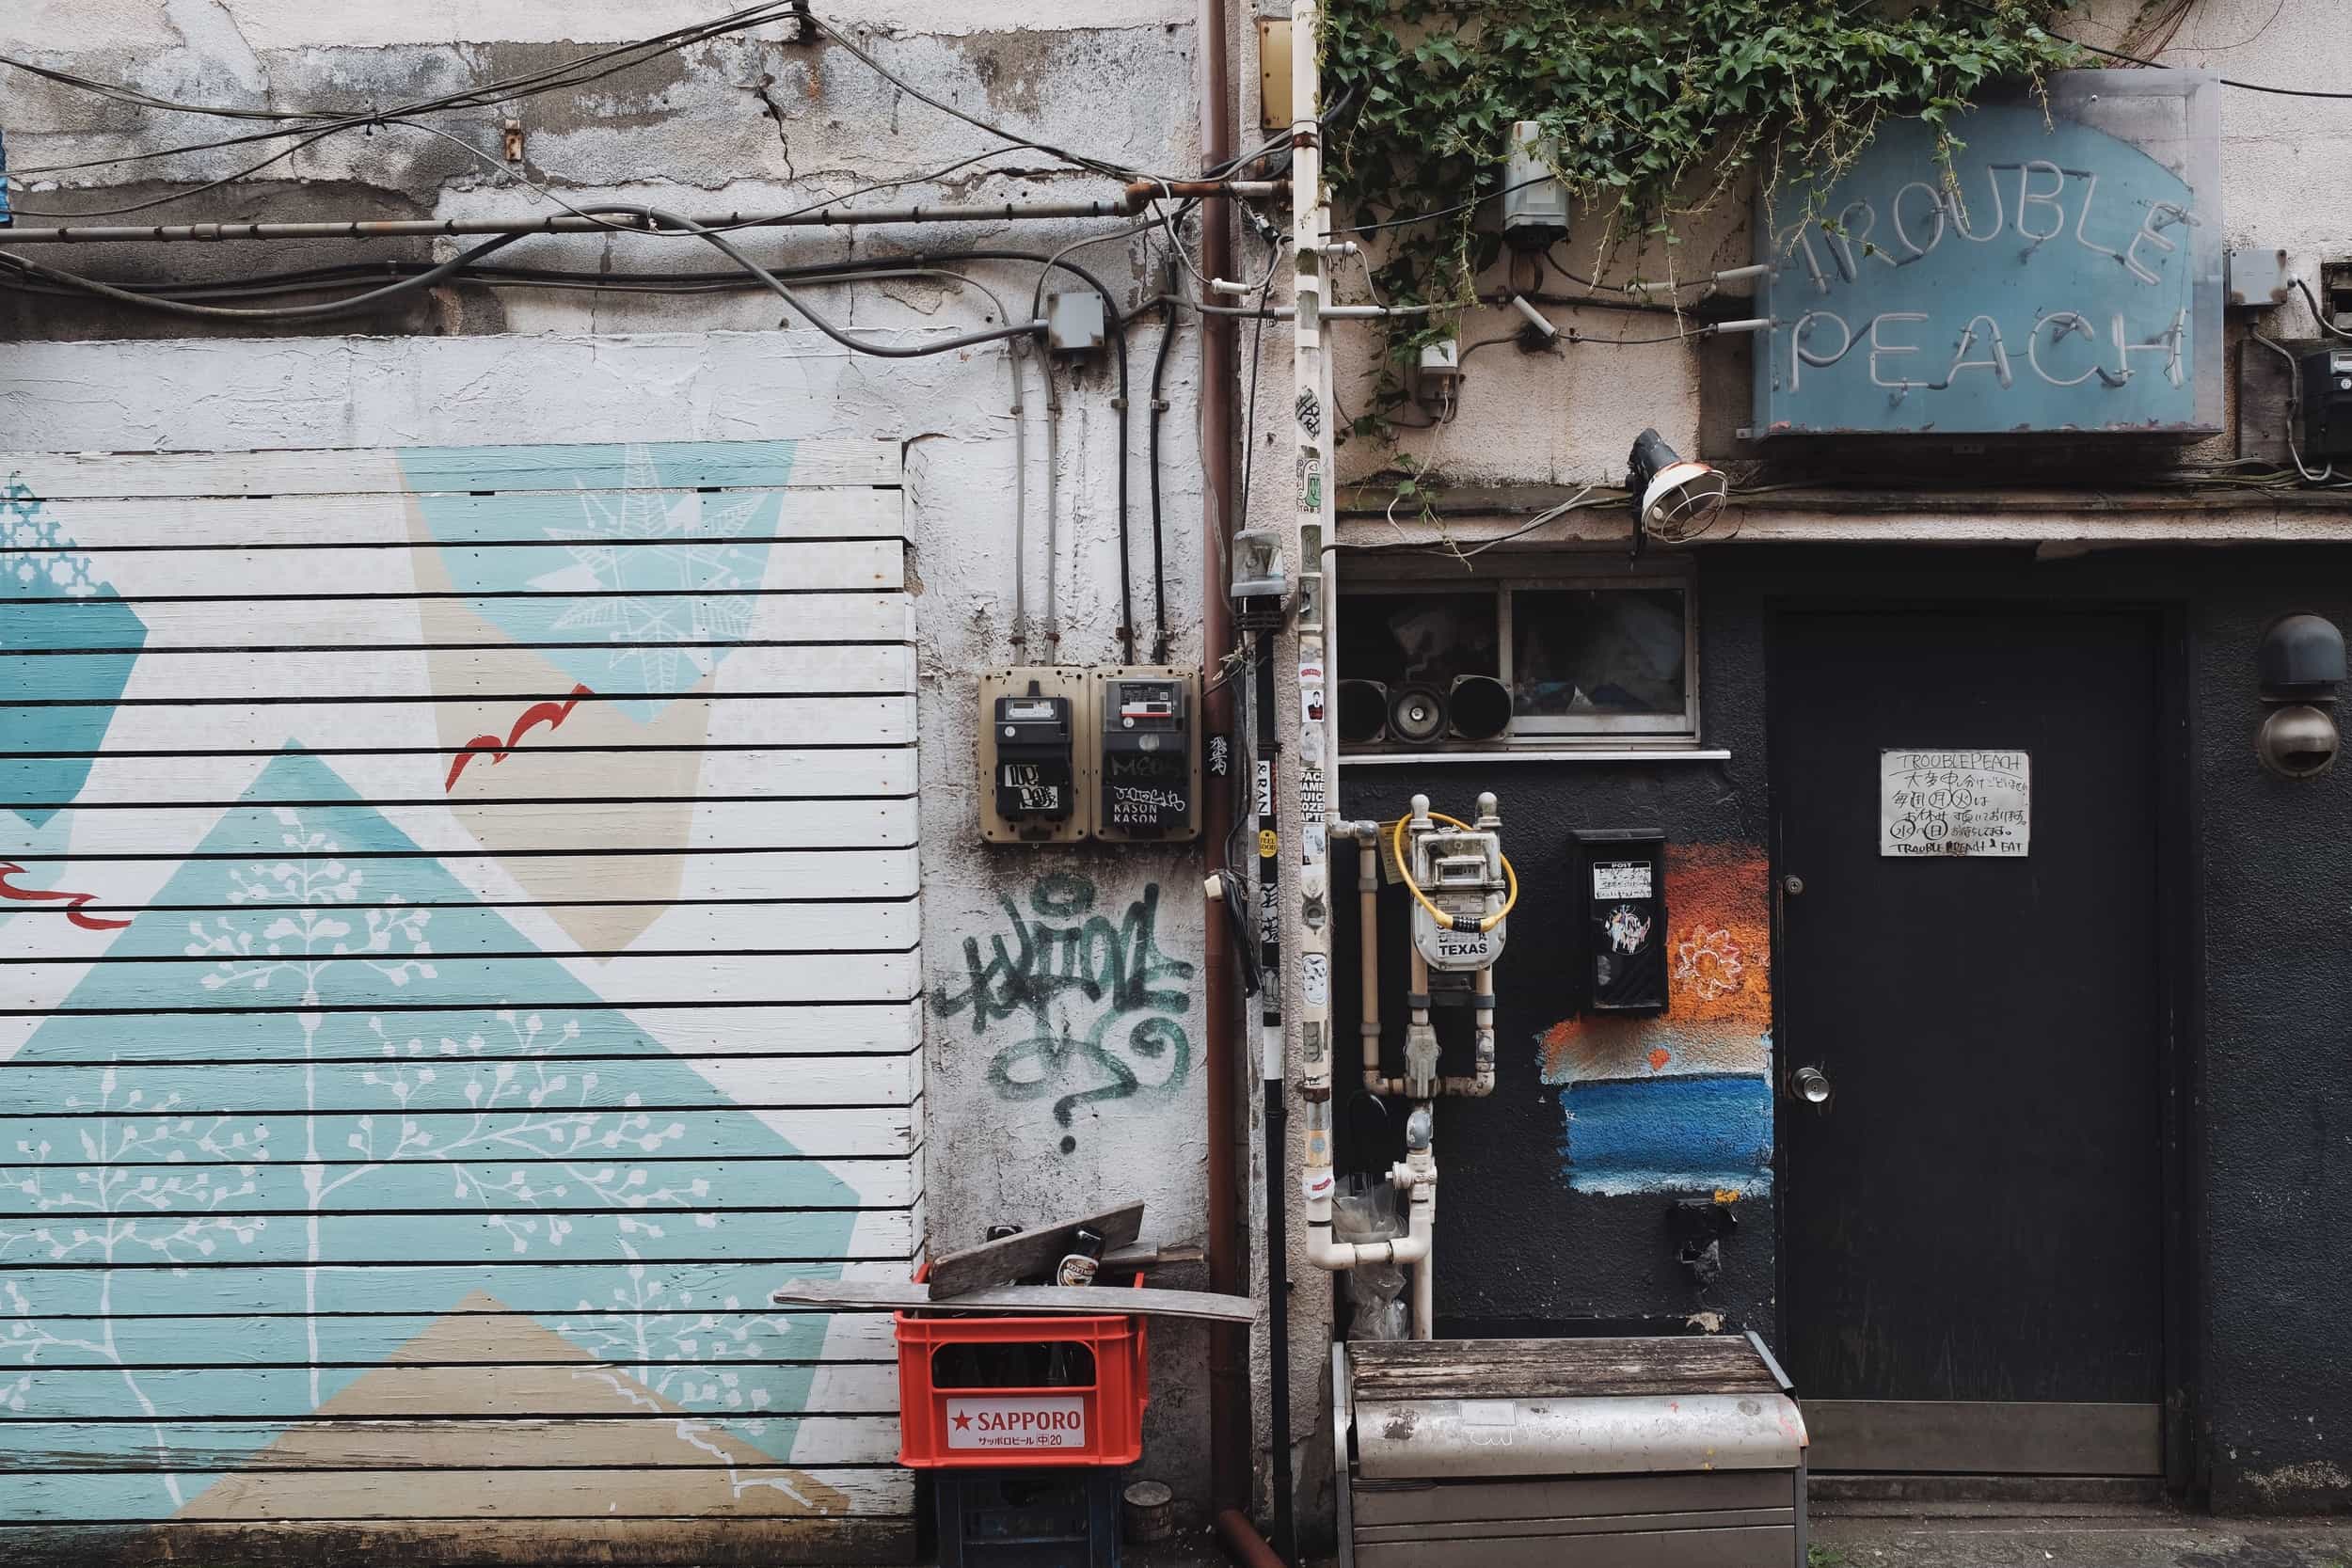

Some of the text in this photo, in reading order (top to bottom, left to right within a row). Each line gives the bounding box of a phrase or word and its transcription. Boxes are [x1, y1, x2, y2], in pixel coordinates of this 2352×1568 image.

[1774, 160, 2201, 294] TROUBLE
[1788, 309, 2186, 391] PEACH
[1114, 804, 1157, 814] KASON
[1114, 814, 1157, 823] KASON
[1438, 943, 1487, 956] TEXAS
[978, 1411, 1081, 1430] SAPPORO
[978, 1436, 1035, 1446] サッポロビール
